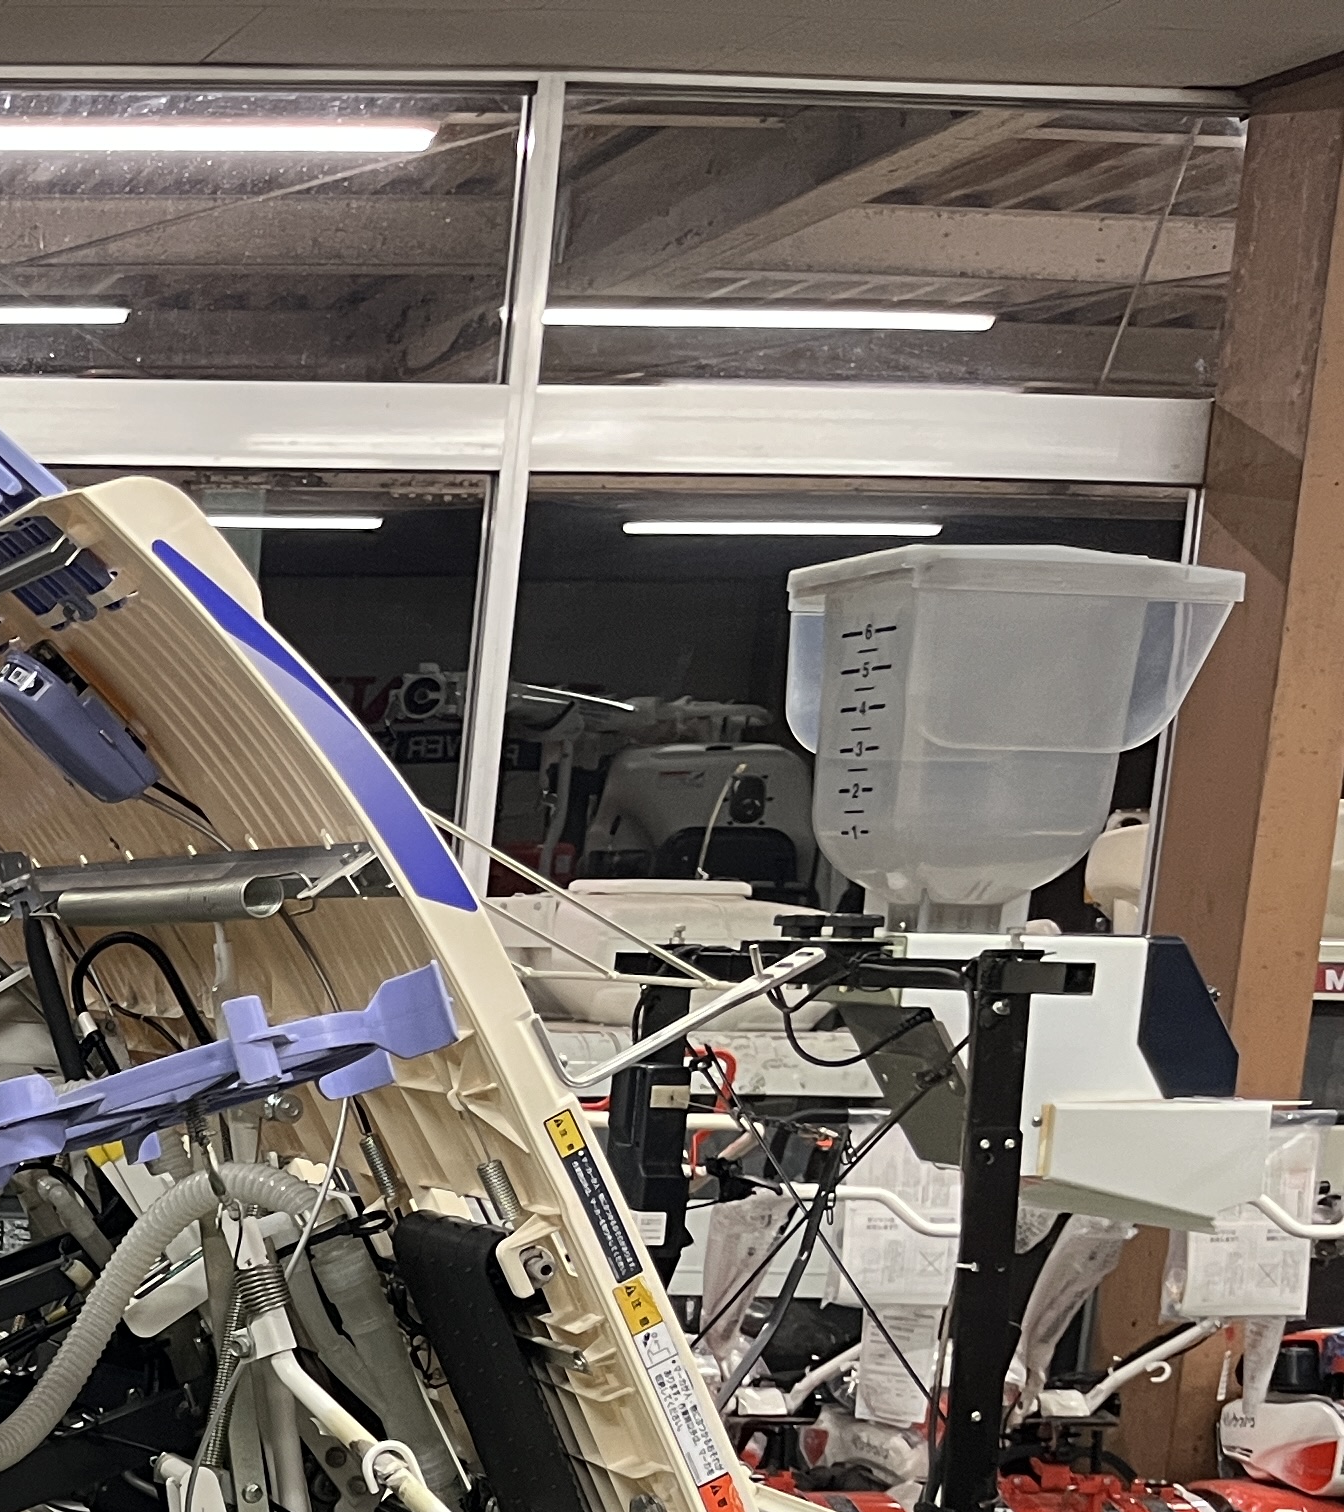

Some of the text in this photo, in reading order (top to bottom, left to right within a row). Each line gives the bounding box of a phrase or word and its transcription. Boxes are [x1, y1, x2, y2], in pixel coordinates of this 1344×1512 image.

[864, 624, 873, 640] 6
[861, 663, 870, 678] 5
[858, 701, 867, 717] 4
[855, 740, 864, 757] 3
[851, 782, 860, 798] 2
[852, 824, 858, 840] 1
